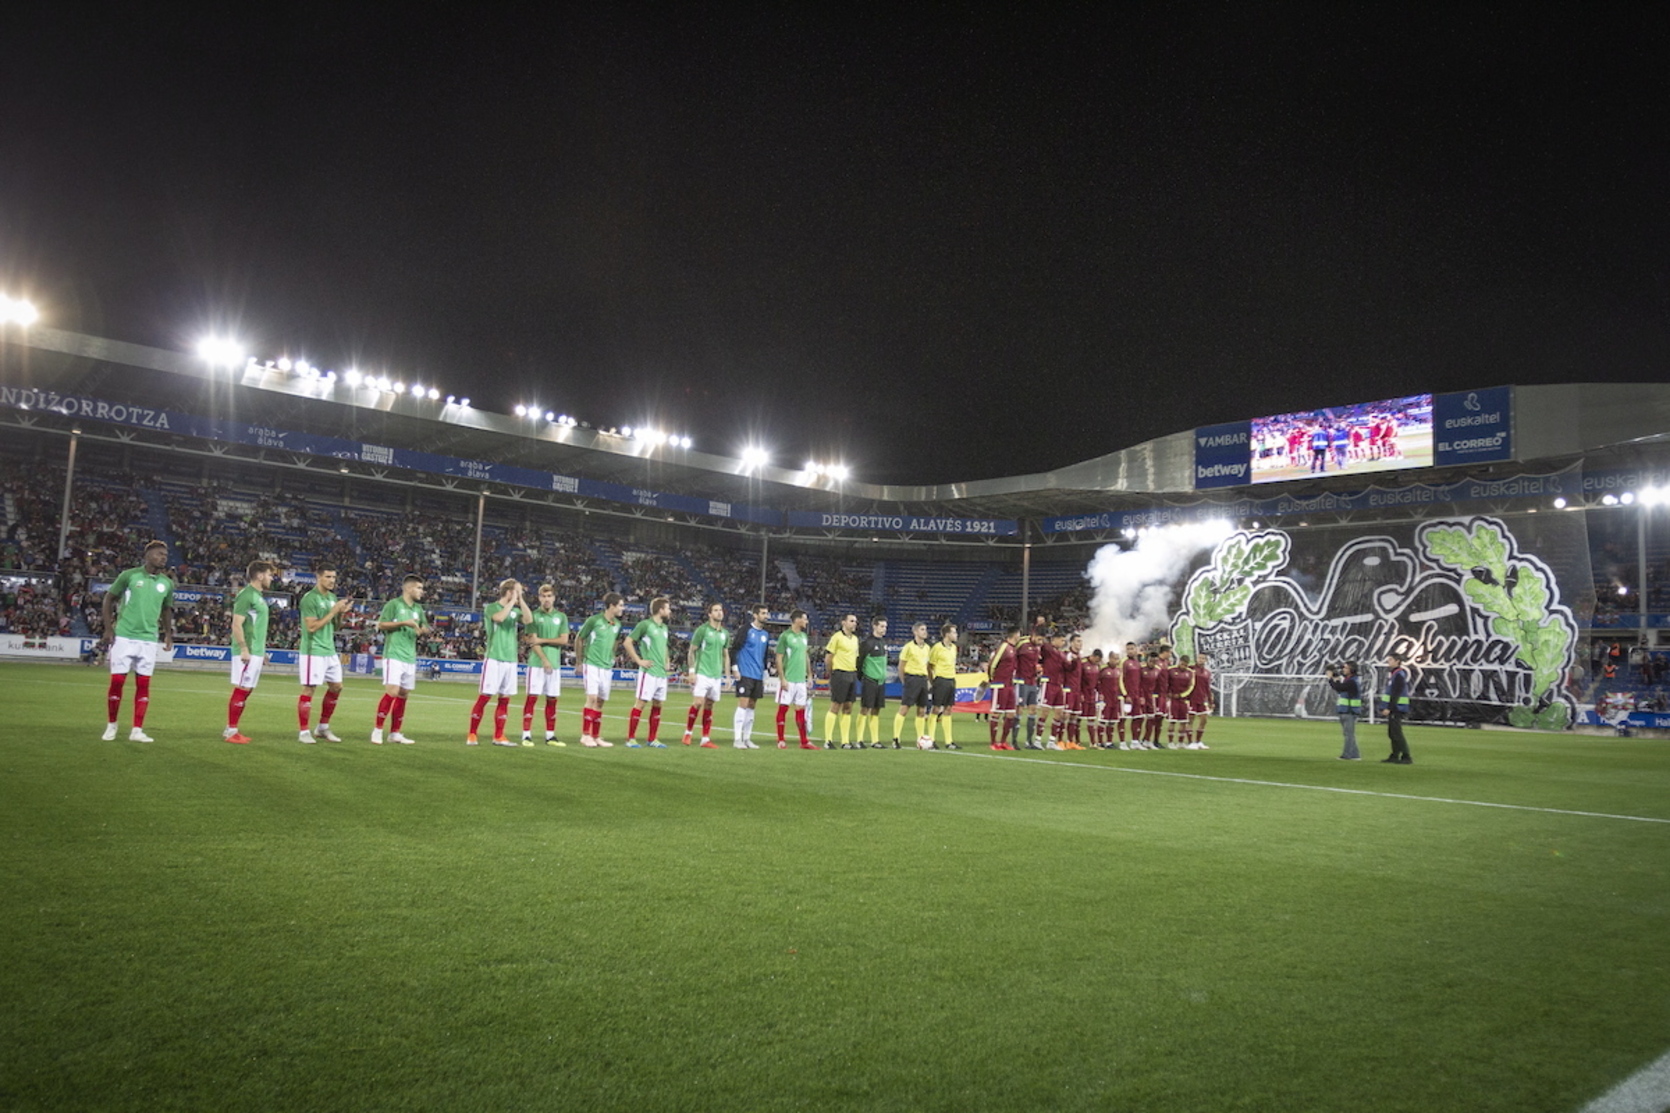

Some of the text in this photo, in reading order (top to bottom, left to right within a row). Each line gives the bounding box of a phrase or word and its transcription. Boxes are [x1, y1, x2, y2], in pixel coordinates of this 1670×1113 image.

[1445, 411, 1500, 429] euskaltel
[248, 426, 277, 438] araba
[1206, 432, 1248, 448] AMBAR
[1438, 442, 1452, 451] EL
[1453, 436, 1502, 450] CORREO
[1198, 463, 1248, 478] betway
[1369, 486, 1434, 506] euskaltel
[1470, 479, 1544, 498] euskaltel
[1278, 497, 1337, 513] euskaltel
[822, 514, 996, 533] DEPORTIVO ALAVÉS 1921
[1055, 515, 1099, 530] euskaltel
[1122, 510, 1172, 526] euskaltel
[186, 646, 226, 660] betway
